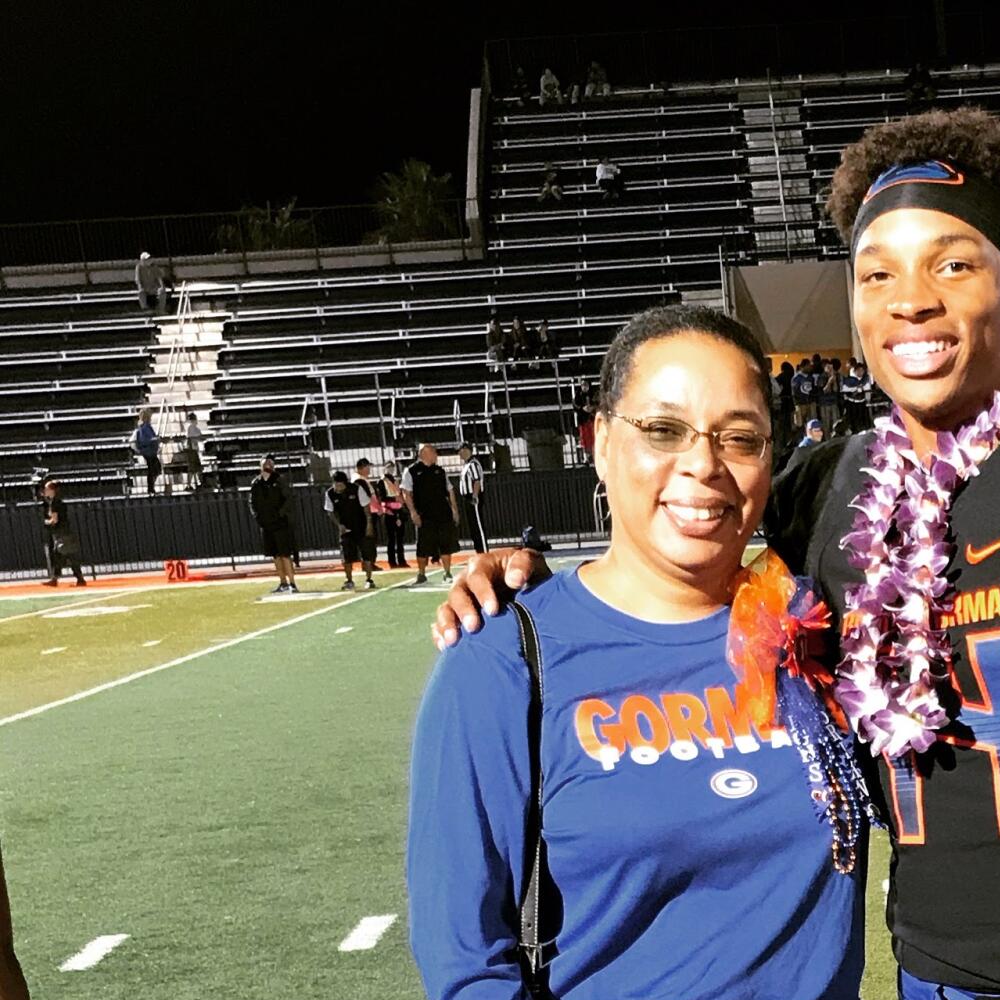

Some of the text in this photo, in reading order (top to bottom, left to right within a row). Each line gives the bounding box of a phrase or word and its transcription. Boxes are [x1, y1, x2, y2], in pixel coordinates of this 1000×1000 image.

[167, 561, 186, 580] 20
[574, 687, 775, 762] GORM
[600, 729, 793, 771] FOOTBA
